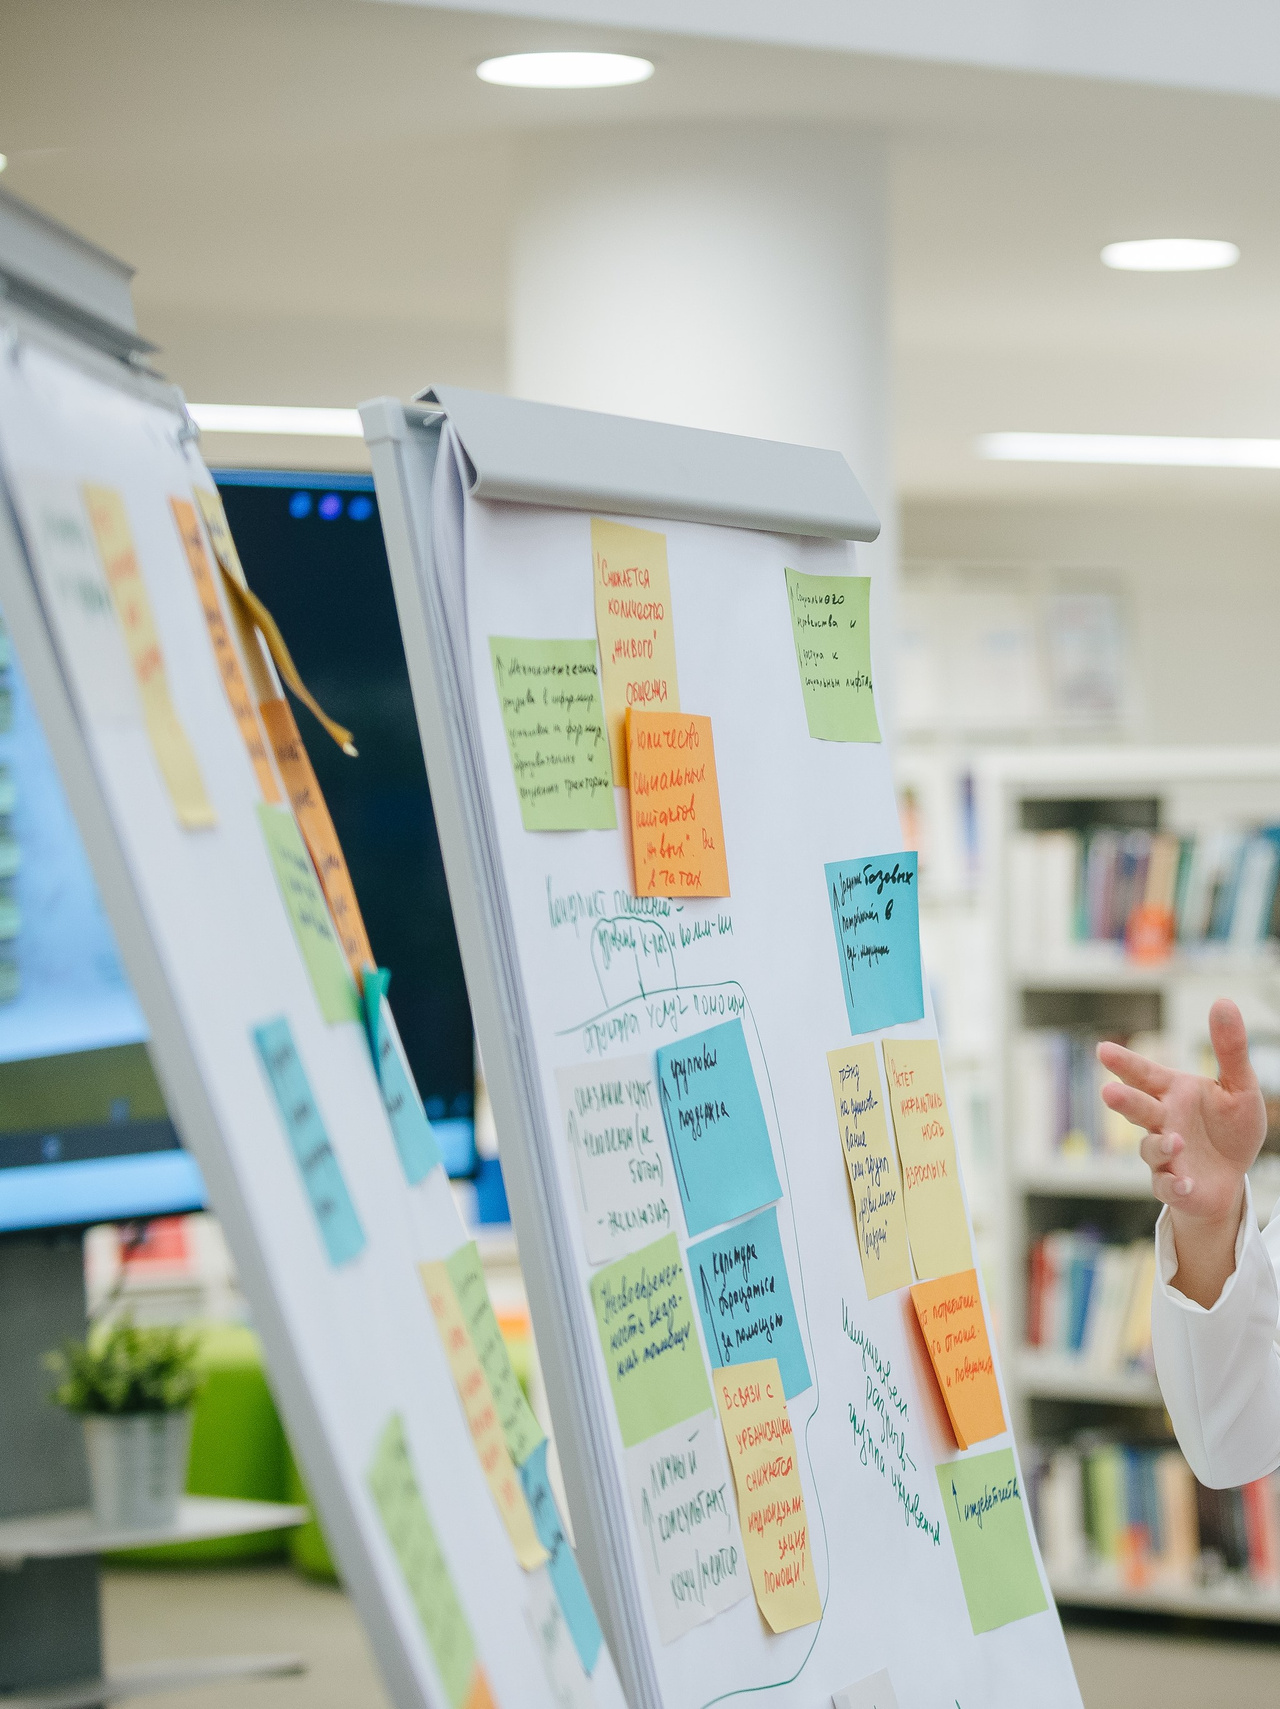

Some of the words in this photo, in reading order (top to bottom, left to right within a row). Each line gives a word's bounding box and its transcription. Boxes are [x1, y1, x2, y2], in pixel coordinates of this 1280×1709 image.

[849, 619, 857, 629] и
[832, 651, 839, 660] к
[863, 863, 914, 895] базовых
[884, 899, 894, 920] в
[905, 1159, 948, 1190] ВЗРОСЛЫХ
[766, 1384, 774, 1398] С
